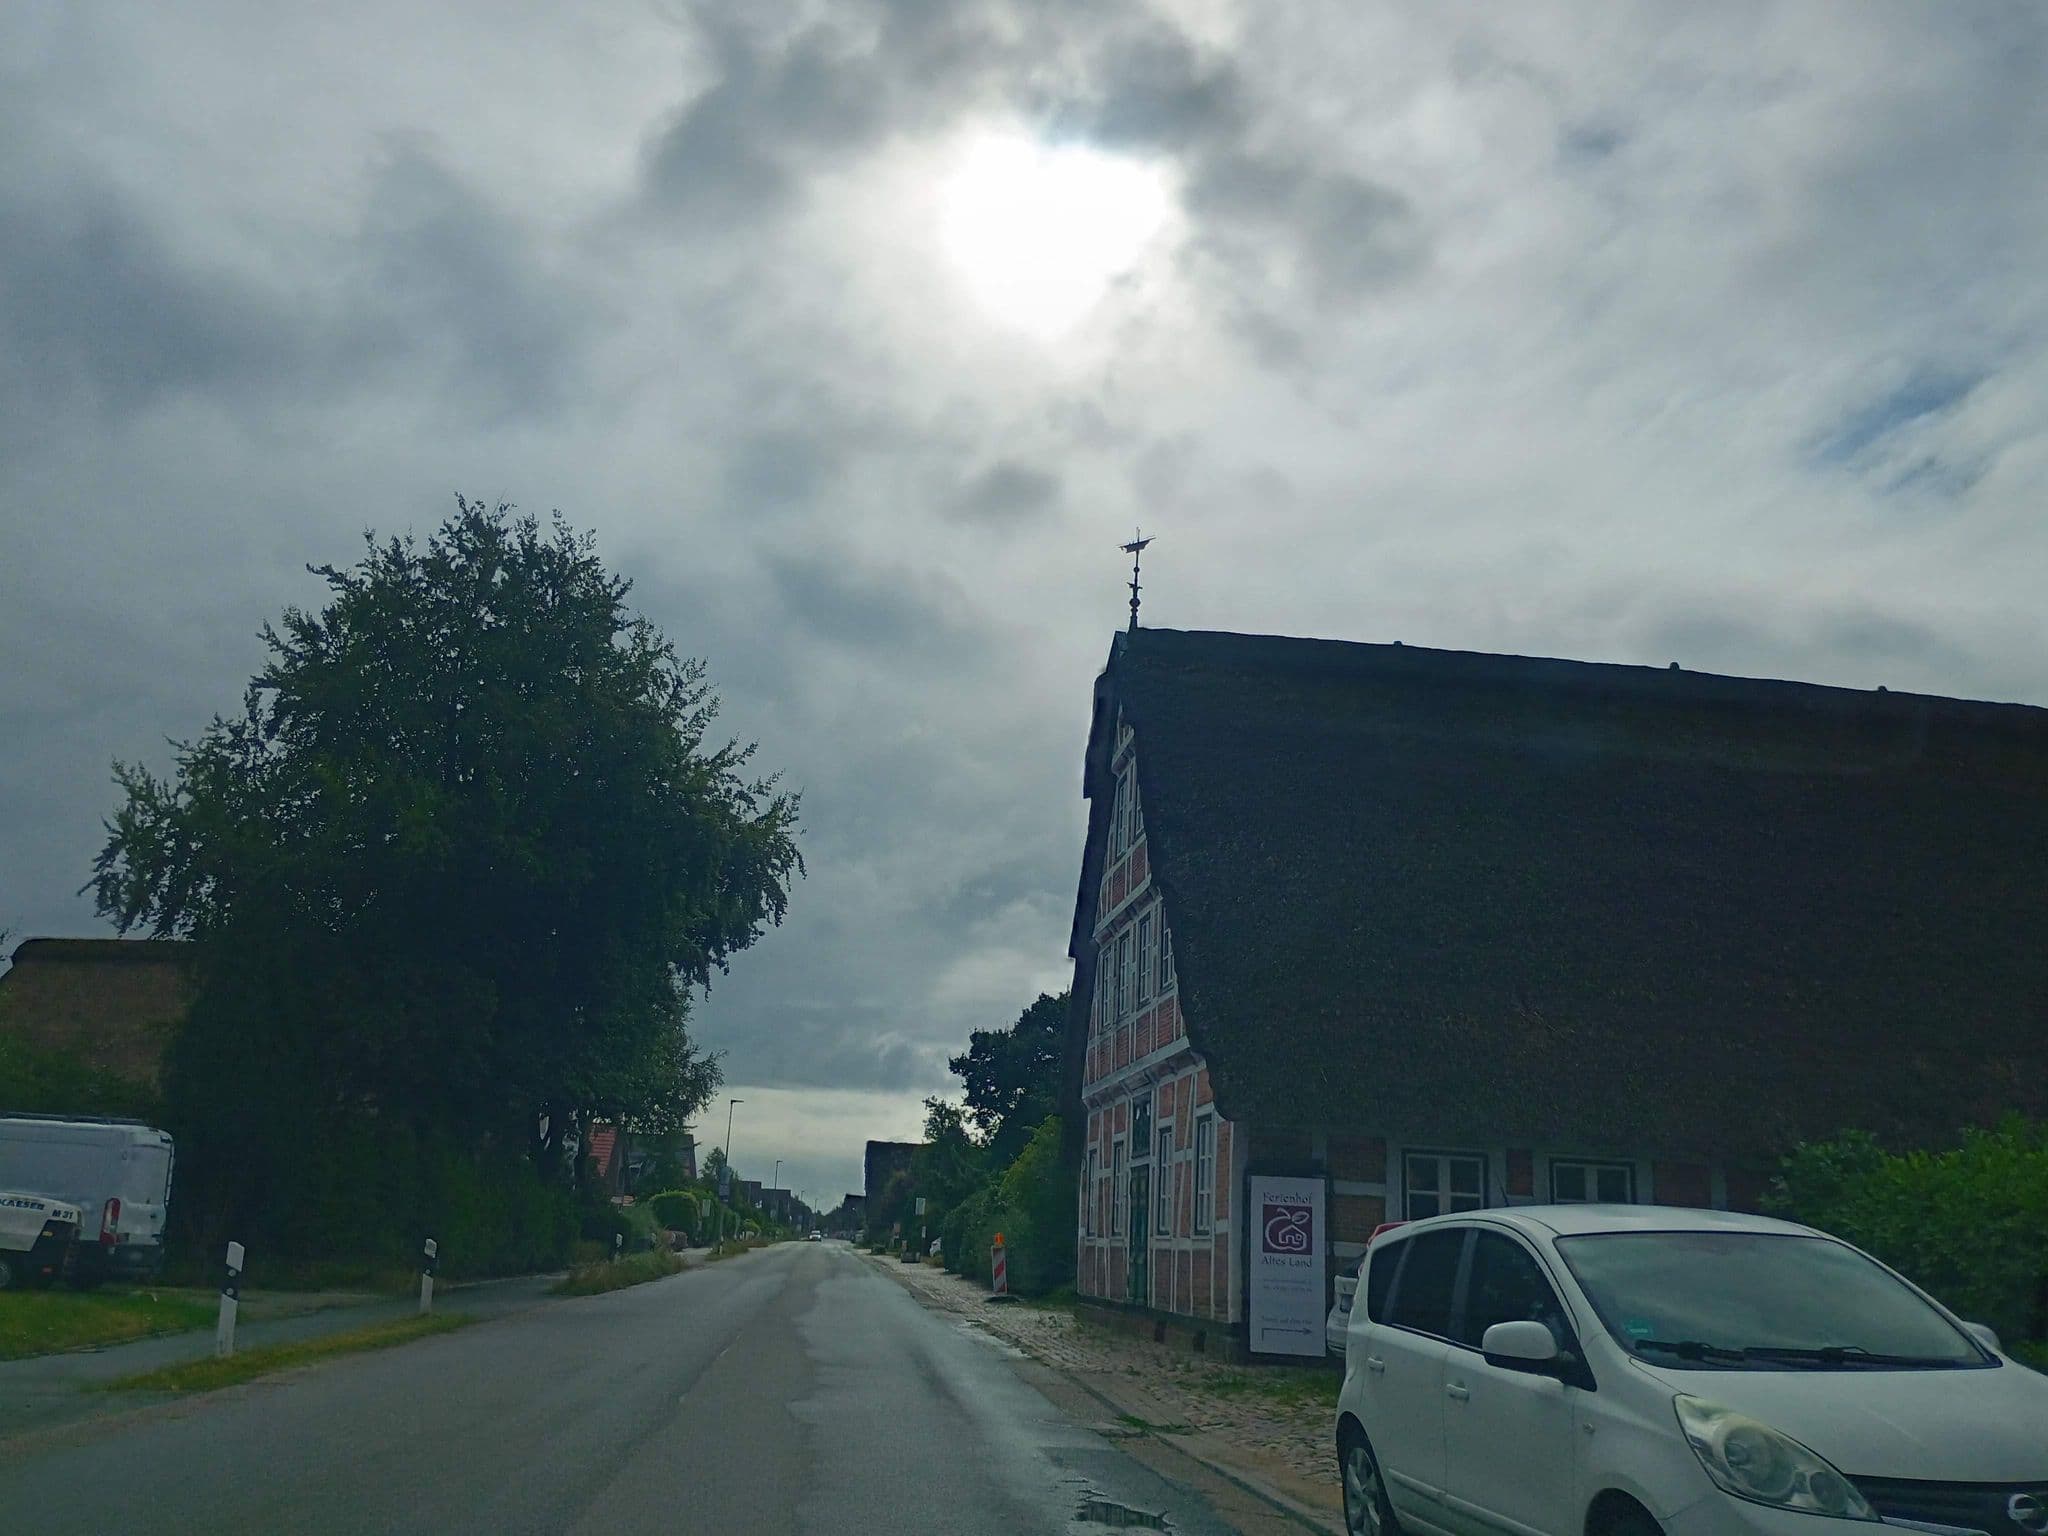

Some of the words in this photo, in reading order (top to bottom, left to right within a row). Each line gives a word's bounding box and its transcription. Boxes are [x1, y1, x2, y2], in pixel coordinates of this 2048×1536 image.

[1263, 1191, 1312, 1204] Ferienhof
[1262, 1255, 1286, 1266] Altes
[1288, 1257, 1312, 1268] Land
